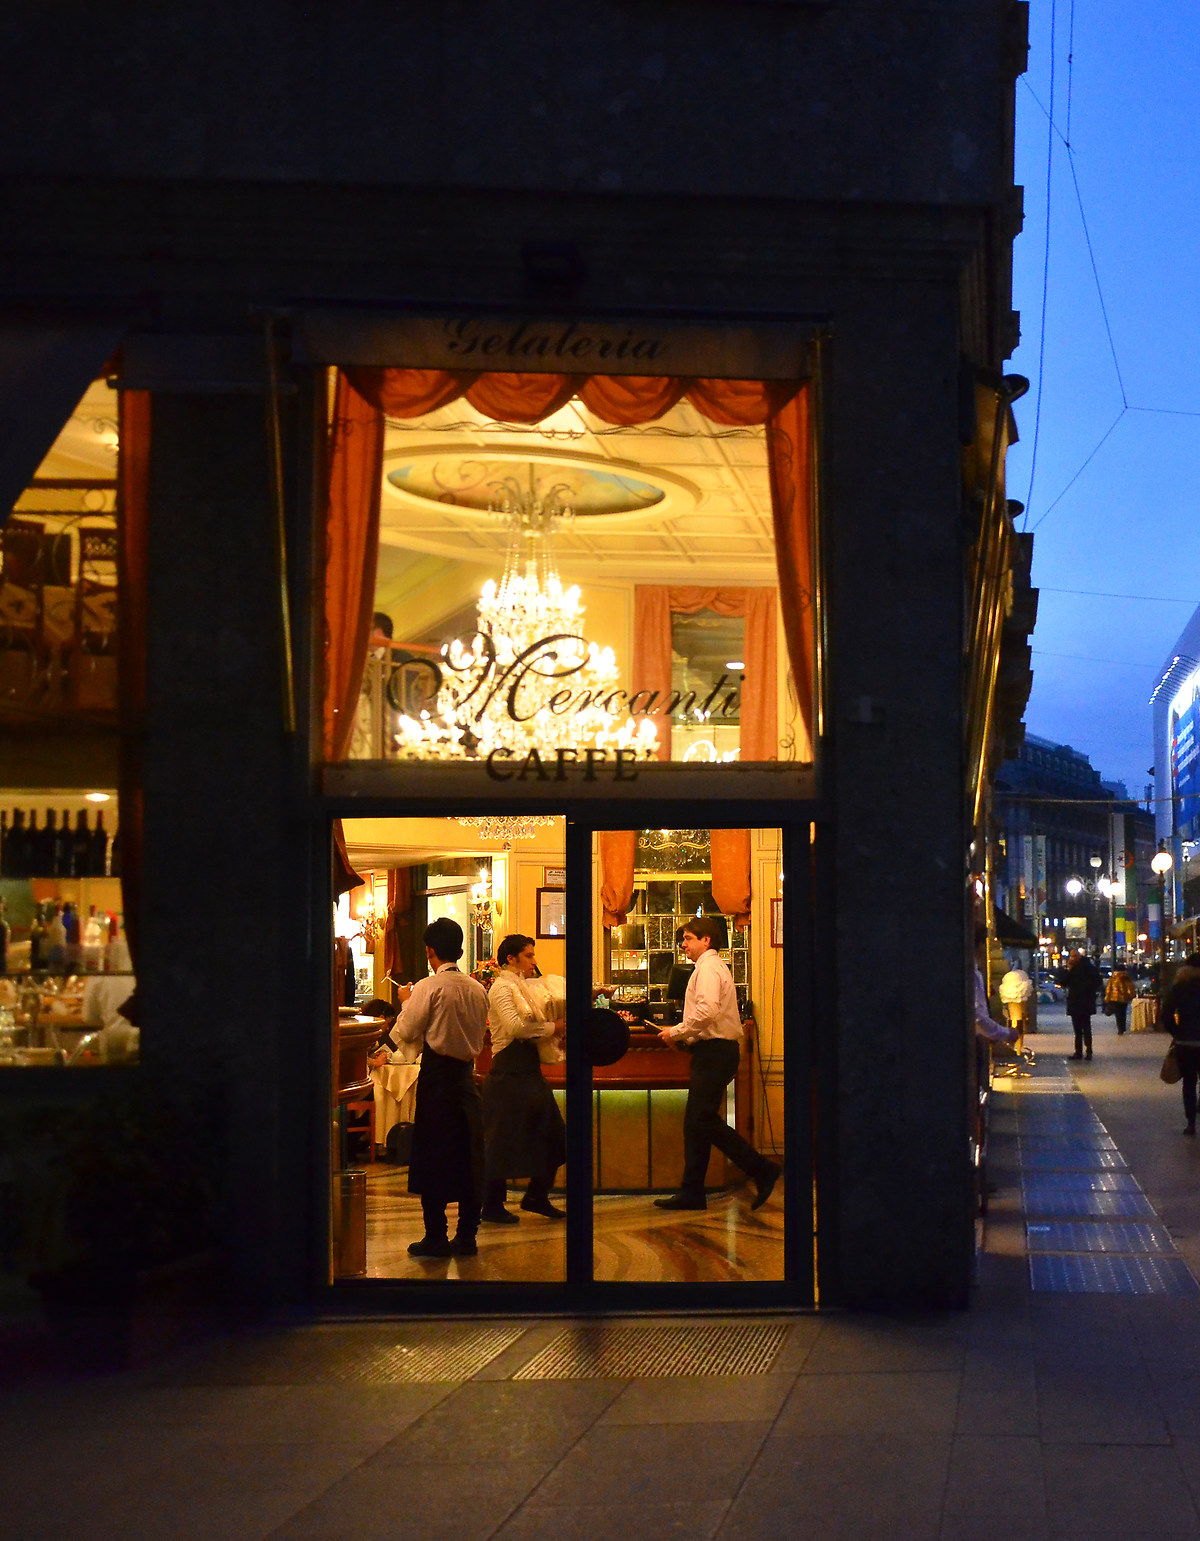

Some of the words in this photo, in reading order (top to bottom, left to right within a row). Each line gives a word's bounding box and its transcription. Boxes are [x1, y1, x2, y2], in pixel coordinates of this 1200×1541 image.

[444, 317, 668, 360] Gelateria
[387, 630, 745, 723] Mercanti
[485, 747, 652, 783] CAFFE'
